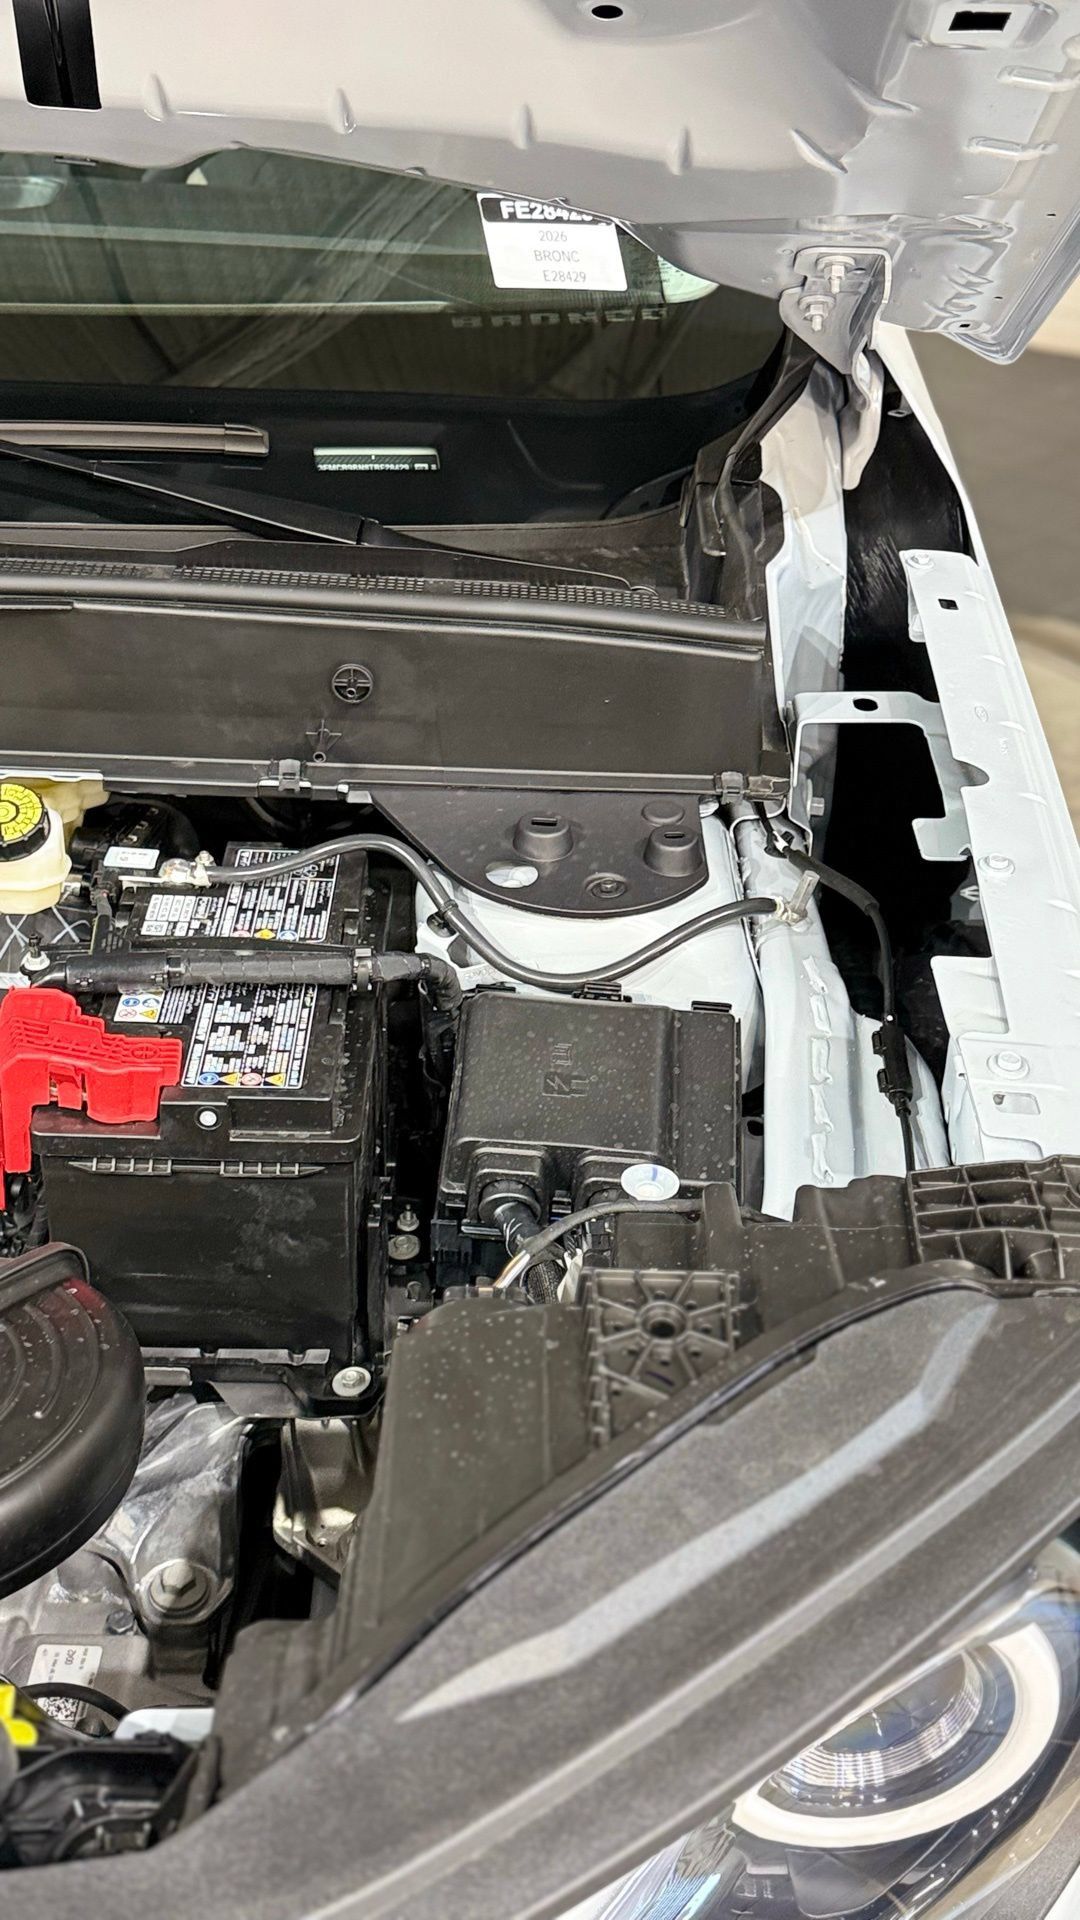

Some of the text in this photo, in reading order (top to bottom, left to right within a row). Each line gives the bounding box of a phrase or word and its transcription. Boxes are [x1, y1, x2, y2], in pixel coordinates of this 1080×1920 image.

[538, 230, 568, 242] 2026
[533, 249, 580, 263] BRONC
[543, 270, 587, 283] E28429
